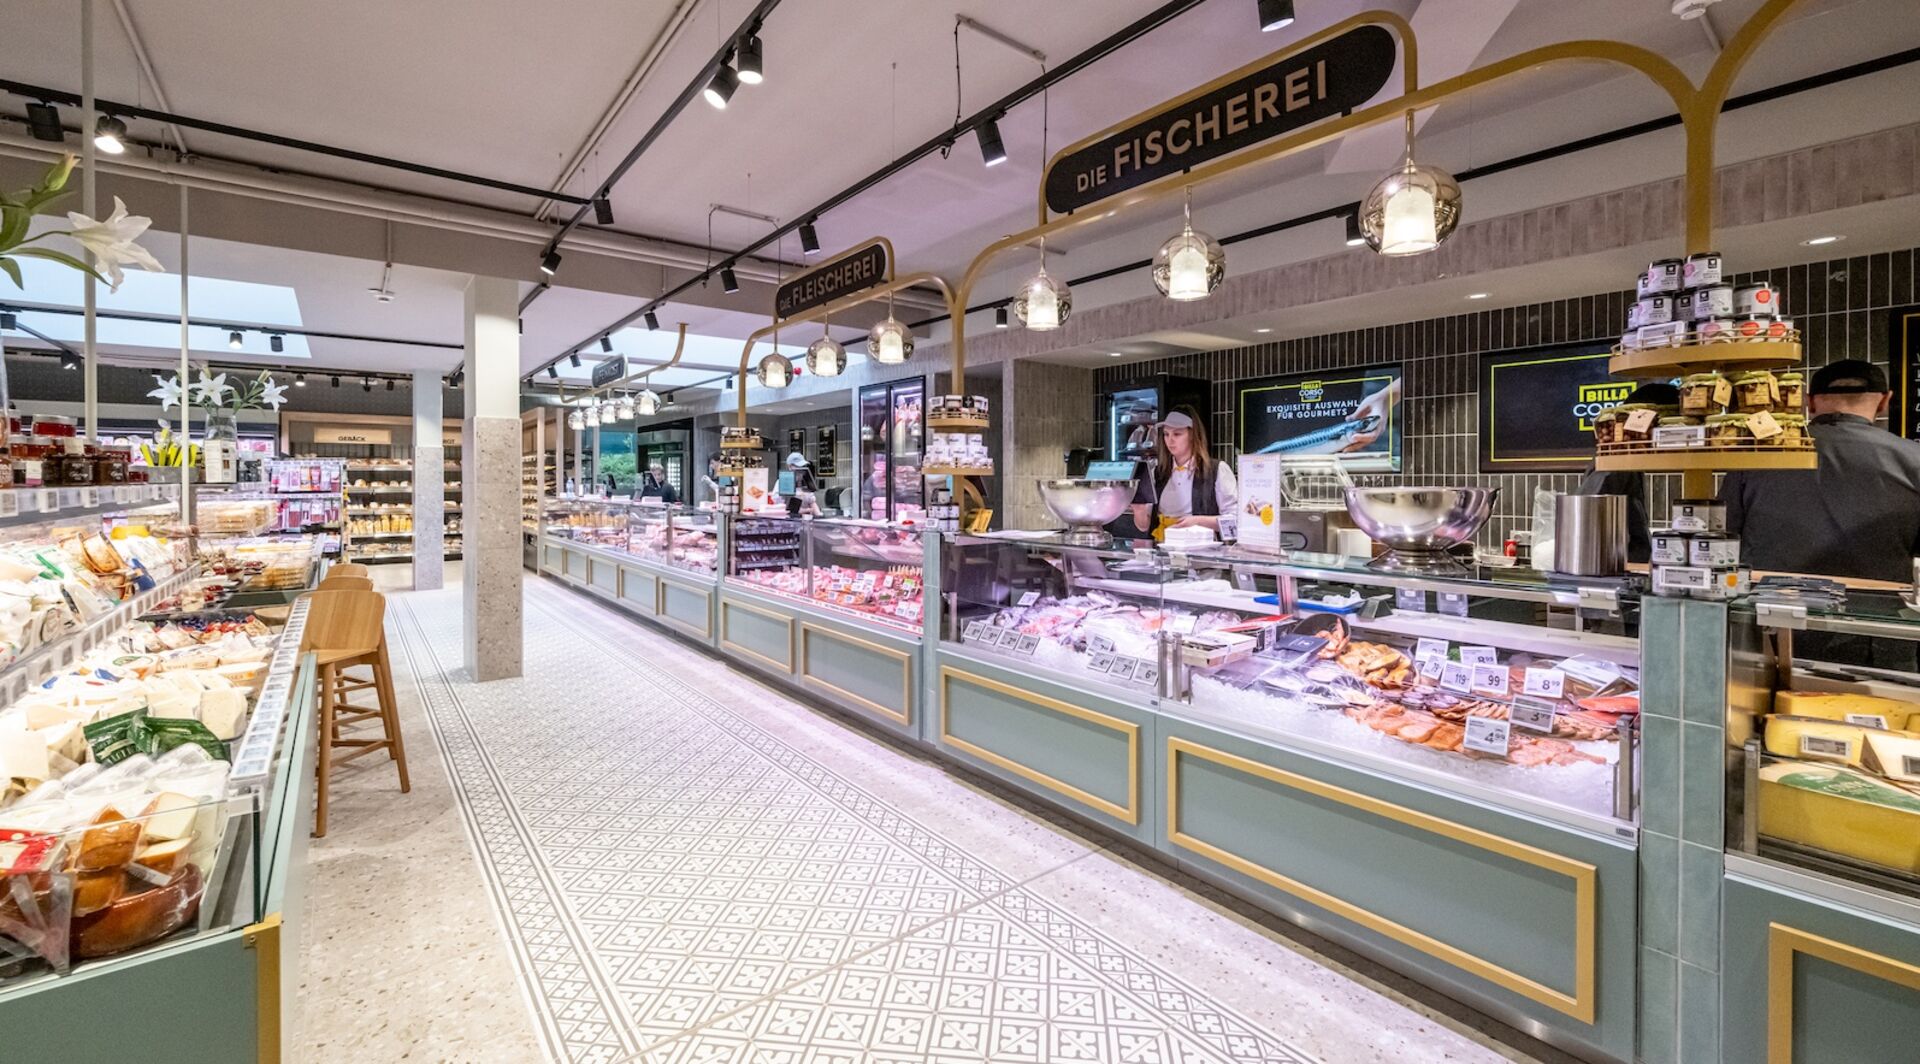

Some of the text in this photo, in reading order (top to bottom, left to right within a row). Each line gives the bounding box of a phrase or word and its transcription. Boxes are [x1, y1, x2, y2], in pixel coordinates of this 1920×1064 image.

[1076, 59, 1327, 193] DIE FISCHEREI
[793, 253, 876, 307] FLEISCHEREI
[1299, 388, 1323, 397] CORSO
[1586, 388, 1629, 402] BILLA
[1266, 399, 1359, 414] EXQUISITE AUSWAHL
[1297, 408, 1348, 419] GOURMETS
